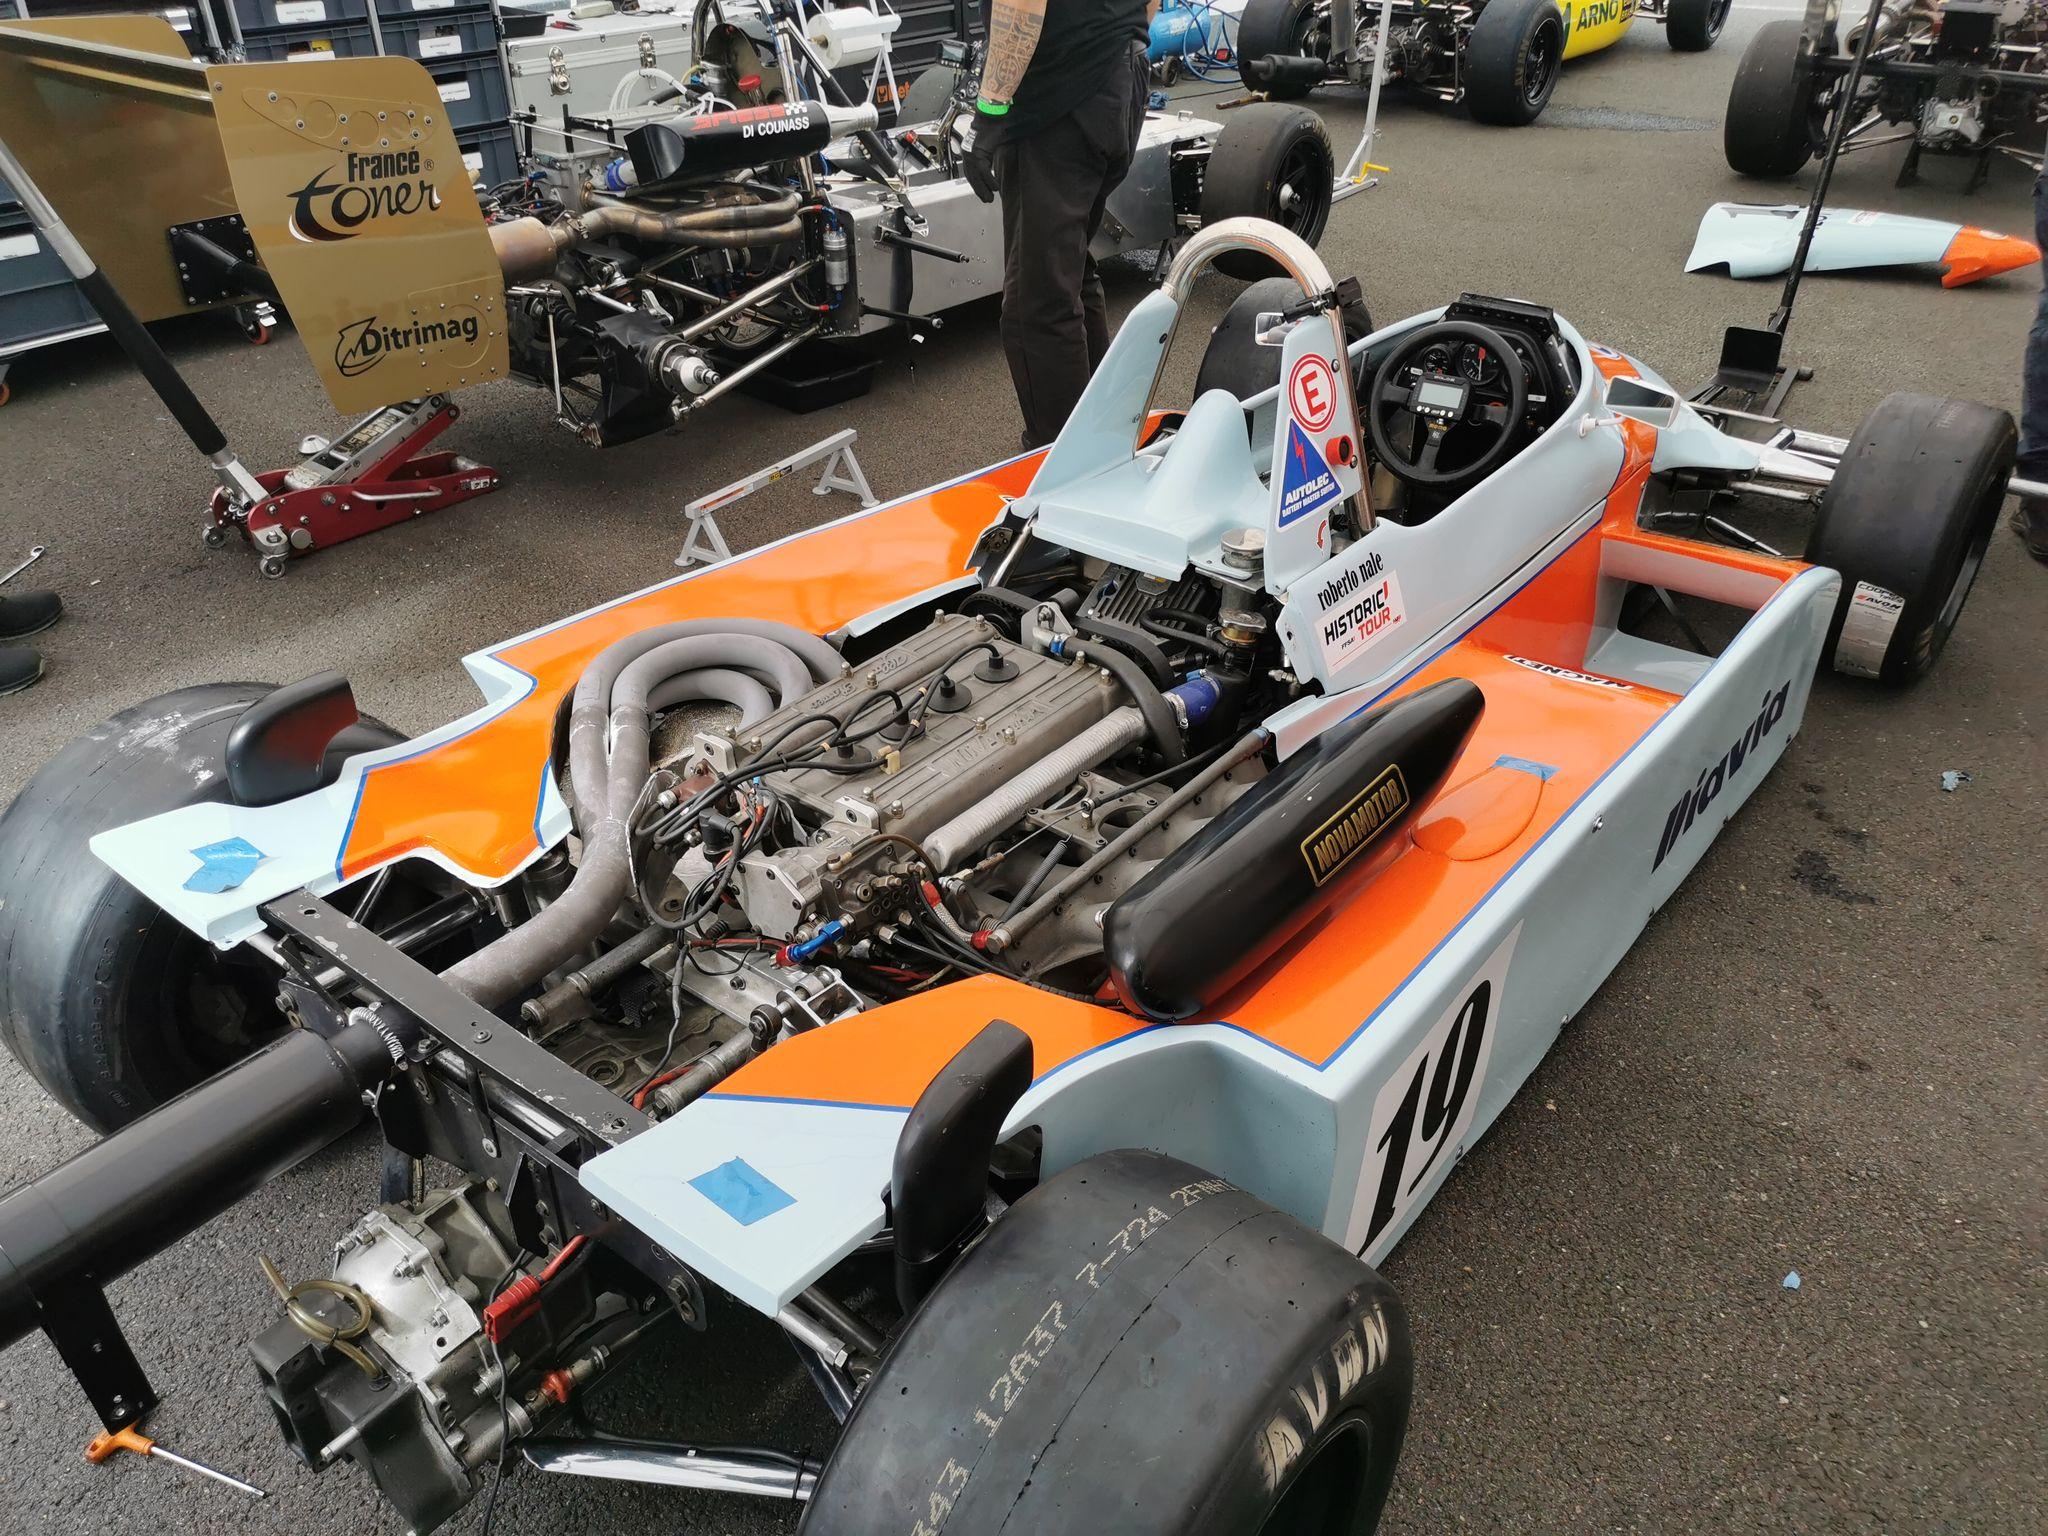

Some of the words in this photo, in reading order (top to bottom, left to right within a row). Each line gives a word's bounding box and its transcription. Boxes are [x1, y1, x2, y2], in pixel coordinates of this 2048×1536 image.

[1576, 0, 1618, 31] ARNO
[743, 125, 755, 138] DI
[757, 116, 810, 137] COUNASS
[286, 164, 441, 242] toner
[361, 316, 478, 356] Ditrimag
[1301, 370, 1327, 417] E
[1282, 501, 1303, 518] BATTERY
[1302, 490, 1321, 506] MASTER
[1285, 472, 1330, 506] AUTOLEC
[1317, 569, 1359, 611] roberto
[1359, 552, 1384, 582] nale
[1324, 588, 1386, 646] HISTORIC
[1358, 606, 1391, 640] TOUR
[1865, 597, 1901, 610] AVON
[1313, 778, 1402, 873] NOVAMOTOR
[1356, 980, 1491, 1258] 19
[1256, 1303, 1389, 1493] AVON
